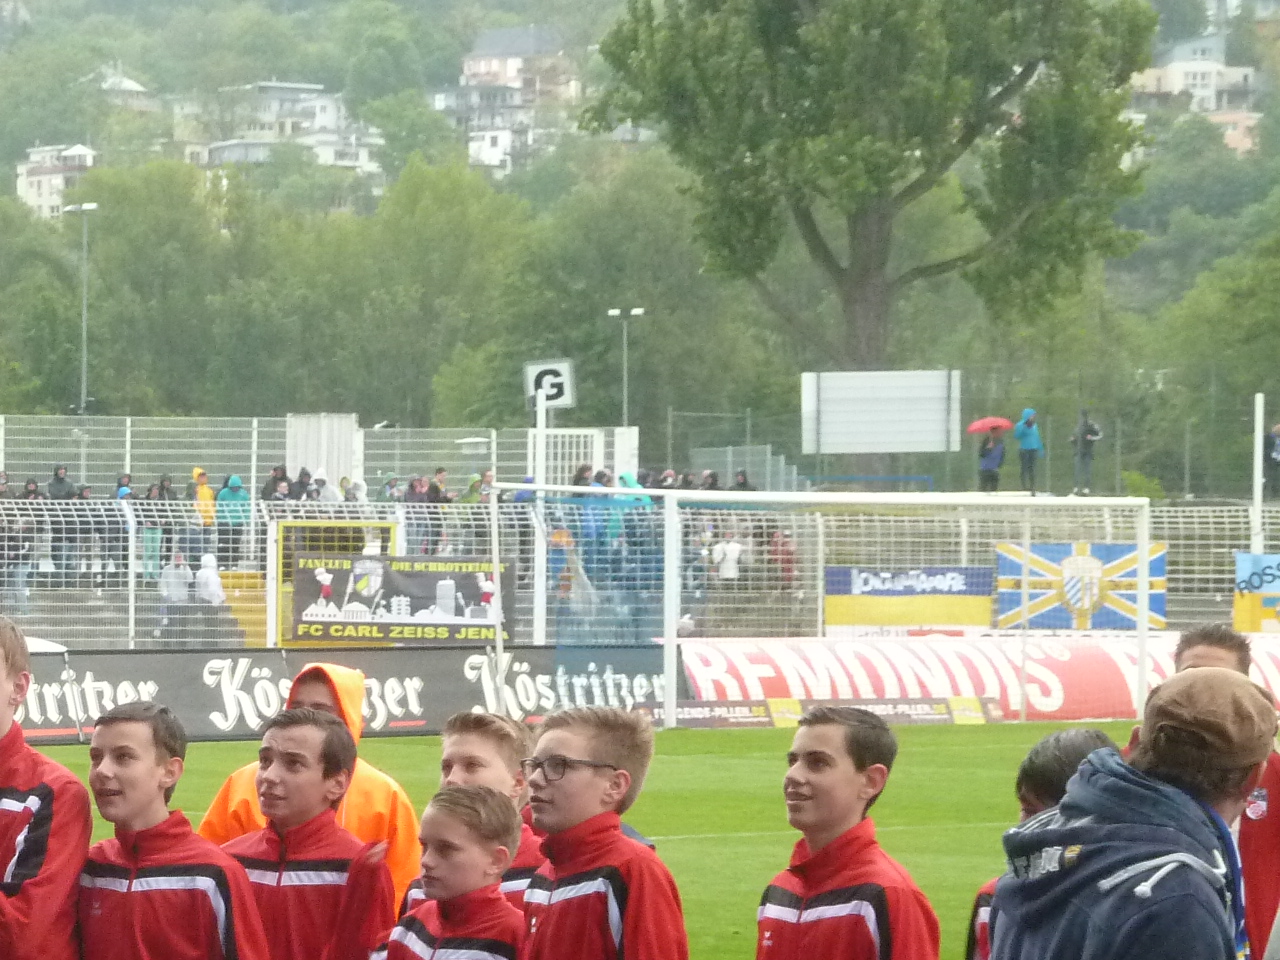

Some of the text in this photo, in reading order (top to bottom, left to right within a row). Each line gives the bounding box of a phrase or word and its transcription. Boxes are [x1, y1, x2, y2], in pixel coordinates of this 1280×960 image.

[534, 369, 565, 401] G
[297, 623, 323, 637] FC
[328, 624, 385, 638] CARL
[388, 625, 450, 639] ZEISS
